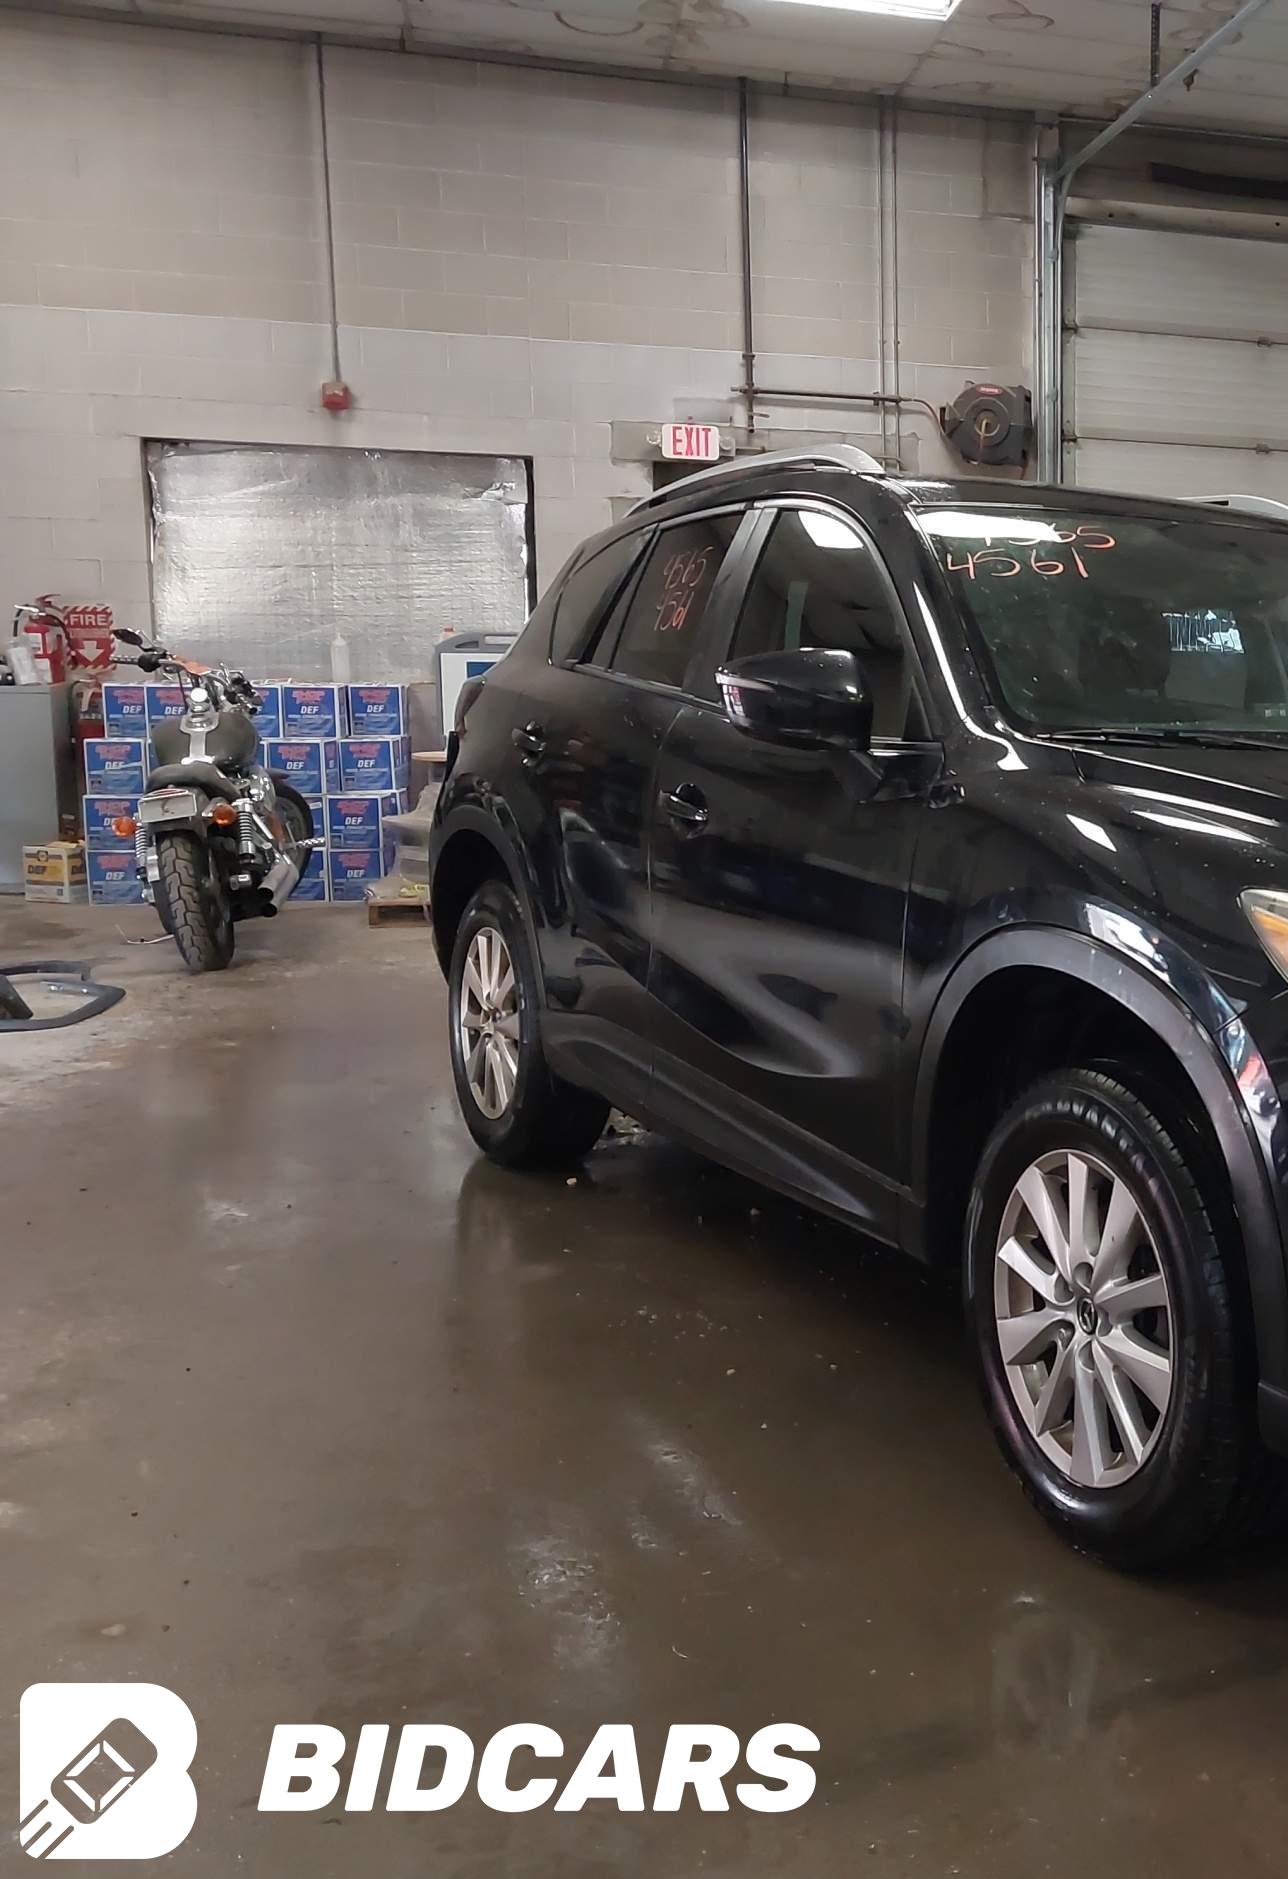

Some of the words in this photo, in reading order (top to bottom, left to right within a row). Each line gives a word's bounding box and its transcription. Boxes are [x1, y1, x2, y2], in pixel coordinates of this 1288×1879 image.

[672, 426, 711, 457] EXIT
[947, 547, 1089, 580] 4561
[69, 613, 108, 626] FIRE
[122, 705, 142, 714] DEF
[164, 706, 185, 715] DEF
[300, 705, 319, 714] DEF
[366, 704, 385, 713] DEF
[105, 761, 124, 770] DEF
[286, 761, 304, 770] DEF
[357, 759, 375, 768] DEF
[345, 816, 364, 825] DEF
[105, 871, 125, 880] DEF
[346, 869, 365, 878] DEF
